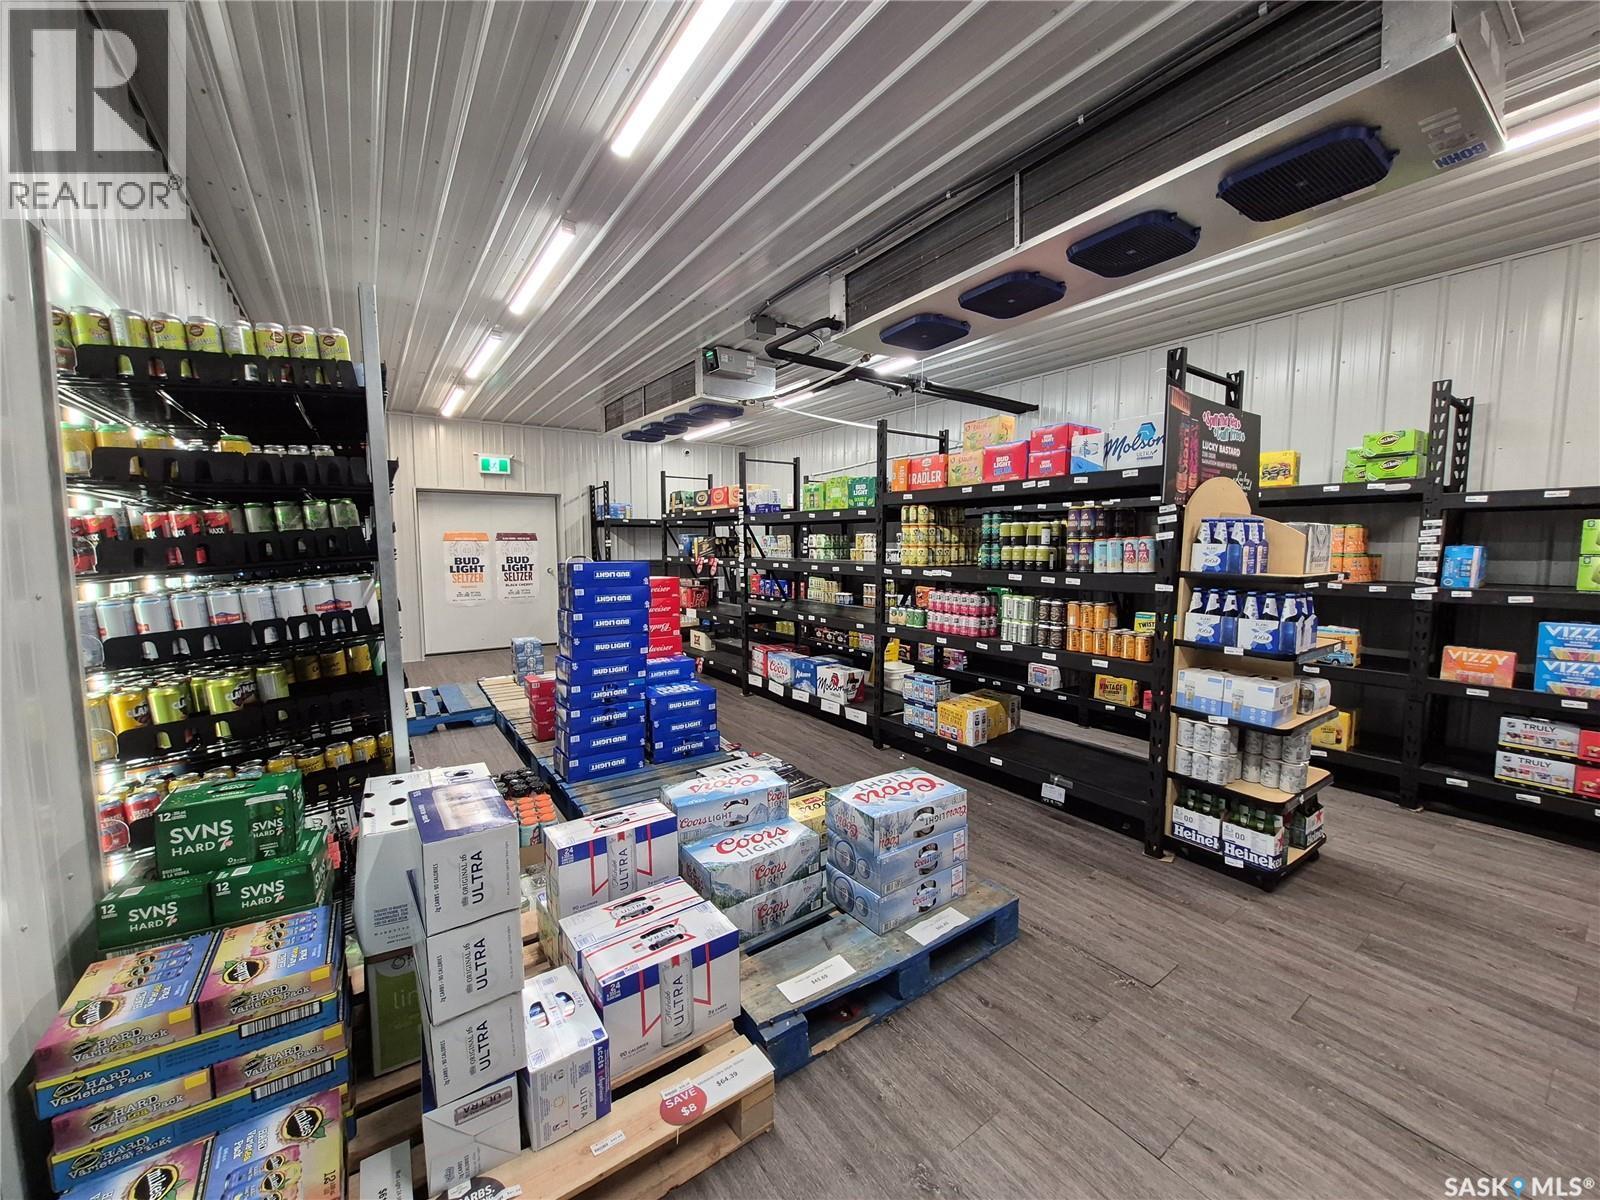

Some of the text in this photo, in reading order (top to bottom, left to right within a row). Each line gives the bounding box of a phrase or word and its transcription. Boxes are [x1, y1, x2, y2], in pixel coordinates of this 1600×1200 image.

[1202, 440, 1218, 453] LUCKY
[1219, 445, 1241, 457] BASTARD
[911, 470, 942, 485] RADLER
[454, 556, 480, 566] BUD
[501, 563, 534, 573] LIGHT
[506, 556, 530, 564] BUD
[449, 565, 485, 574] LIGHT
[504, 571, 533, 582] SELTZER
[452, 573, 484, 584] SELTZER
[597, 595, 617, 603] LIGHT
[594, 619, 615, 627] LIGHT
[1138, 621, 1156, 629] TWIST
[610, 641, 631, 649] LIGHT
[1447, 648, 1510, 666] VIZZY
[593, 667, 608, 675] BUD
[769, 661, 788, 676] Coors
[669, 699, 701, 709] BUD LIGHT
[671, 721, 702, 731] BUD LIGHT
[1522, 722, 1558, 733] TRULY
[591, 735, 627, 746] BUD LIGHT
[591, 758, 626, 770] BUD LIGHT
[1517, 756, 1552, 768] TRULY
[688, 773, 761, 794] Coors
[853, 775, 945, 804] Coors
[855, 774, 910, 793] LIGHT
[158, 812, 172, 823] 12
[679, 811, 733, 829] Coors LIGHT
[924, 804, 967, 826] Coors LIGHT
[169, 819, 234, 844] SVNS
[252, 817, 284, 832] SVNS
[253, 829, 275, 838] HARD
[712, 824, 790, 855] Coors
[171, 841, 216, 857] HARD
[736, 838, 786, 858] LIGHT
[459, 854, 469, 895] ORIGINAL 16
[618, 847, 629, 891] ULTRA
[754, 860, 787, 881] Coors
[470, 850, 484, 905] ULTRA
[759, 871, 784, 887] LIGHT
[215, 881, 230, 892] 12
[240, 879, 286, 900] SVNS
[100, 903, 116, 915] 12
[241, 895, 273, 909] HARD
[757, 898, 790, 920] Coors
[128, 901, 178, 922] SVNS
[761, 910, 786, 926] LIGHT
[129, 918, 164, 933] HARD
[465, 943, 474, 985] ORIGINAL 16
[473, 937, 488, 991] ULTRA
[250, 984, 289, 1001] HARD
[282, 985, 311, 1001] Pack
[610, 981, 621, 991] 24
[672, 973, 685, 1028] ULTRA
[97, 1028, 142, 1048] HARD
[135, 1029, 169, 1044] Pack
[264, 1043, 303, 1064] HARD
[295, 1043, 325, 1060] Pack
[467, 1026, 476, 1069] ORIGINAL 16
[475, 1020, 491, 1073] ULTRA
[86, 1068, 131, 1090] HARD
[50, 1070, 153, 1108] Varietea Pack
[113, 1094, 159, 1118] HARD
[152, 1095, 184, 1112] Pack
[578, 1087, 588, 1119] ULTRA
[665, 1087, 698, 1109] SAVE
[680, 1103, 697, 1117] $8
[294, 1110, 314, 1137] mike's
